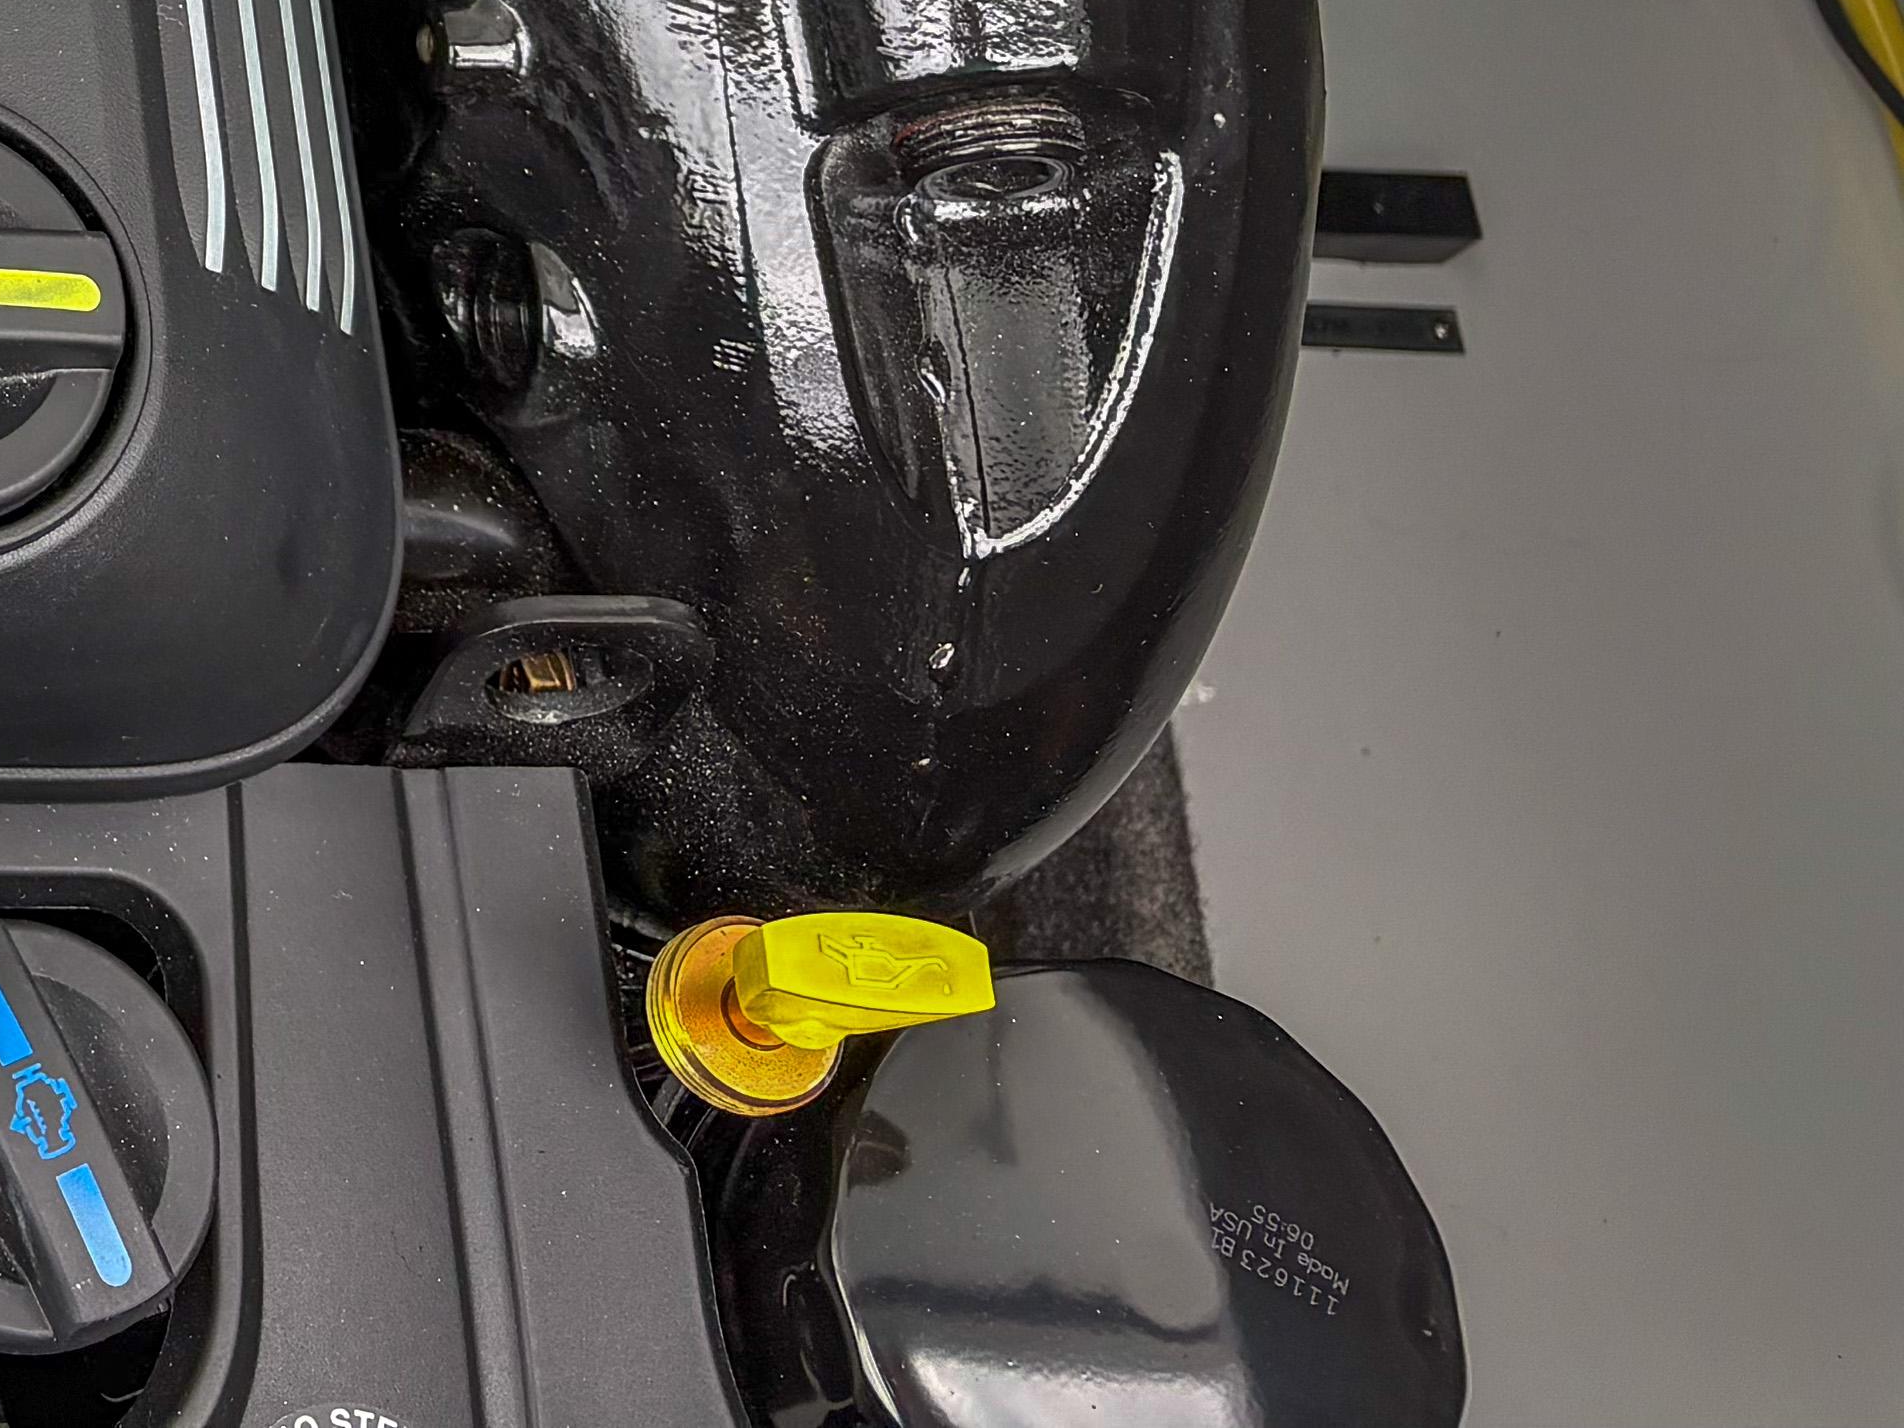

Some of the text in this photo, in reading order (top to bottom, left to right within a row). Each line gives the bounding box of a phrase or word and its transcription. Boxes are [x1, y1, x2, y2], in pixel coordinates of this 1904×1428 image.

[1209, 1201, 1350, 1296] Made In USA
[1251, 1205, 1314, 1251] 06:55
[1240, 1249, 1340, 1316] 111623
